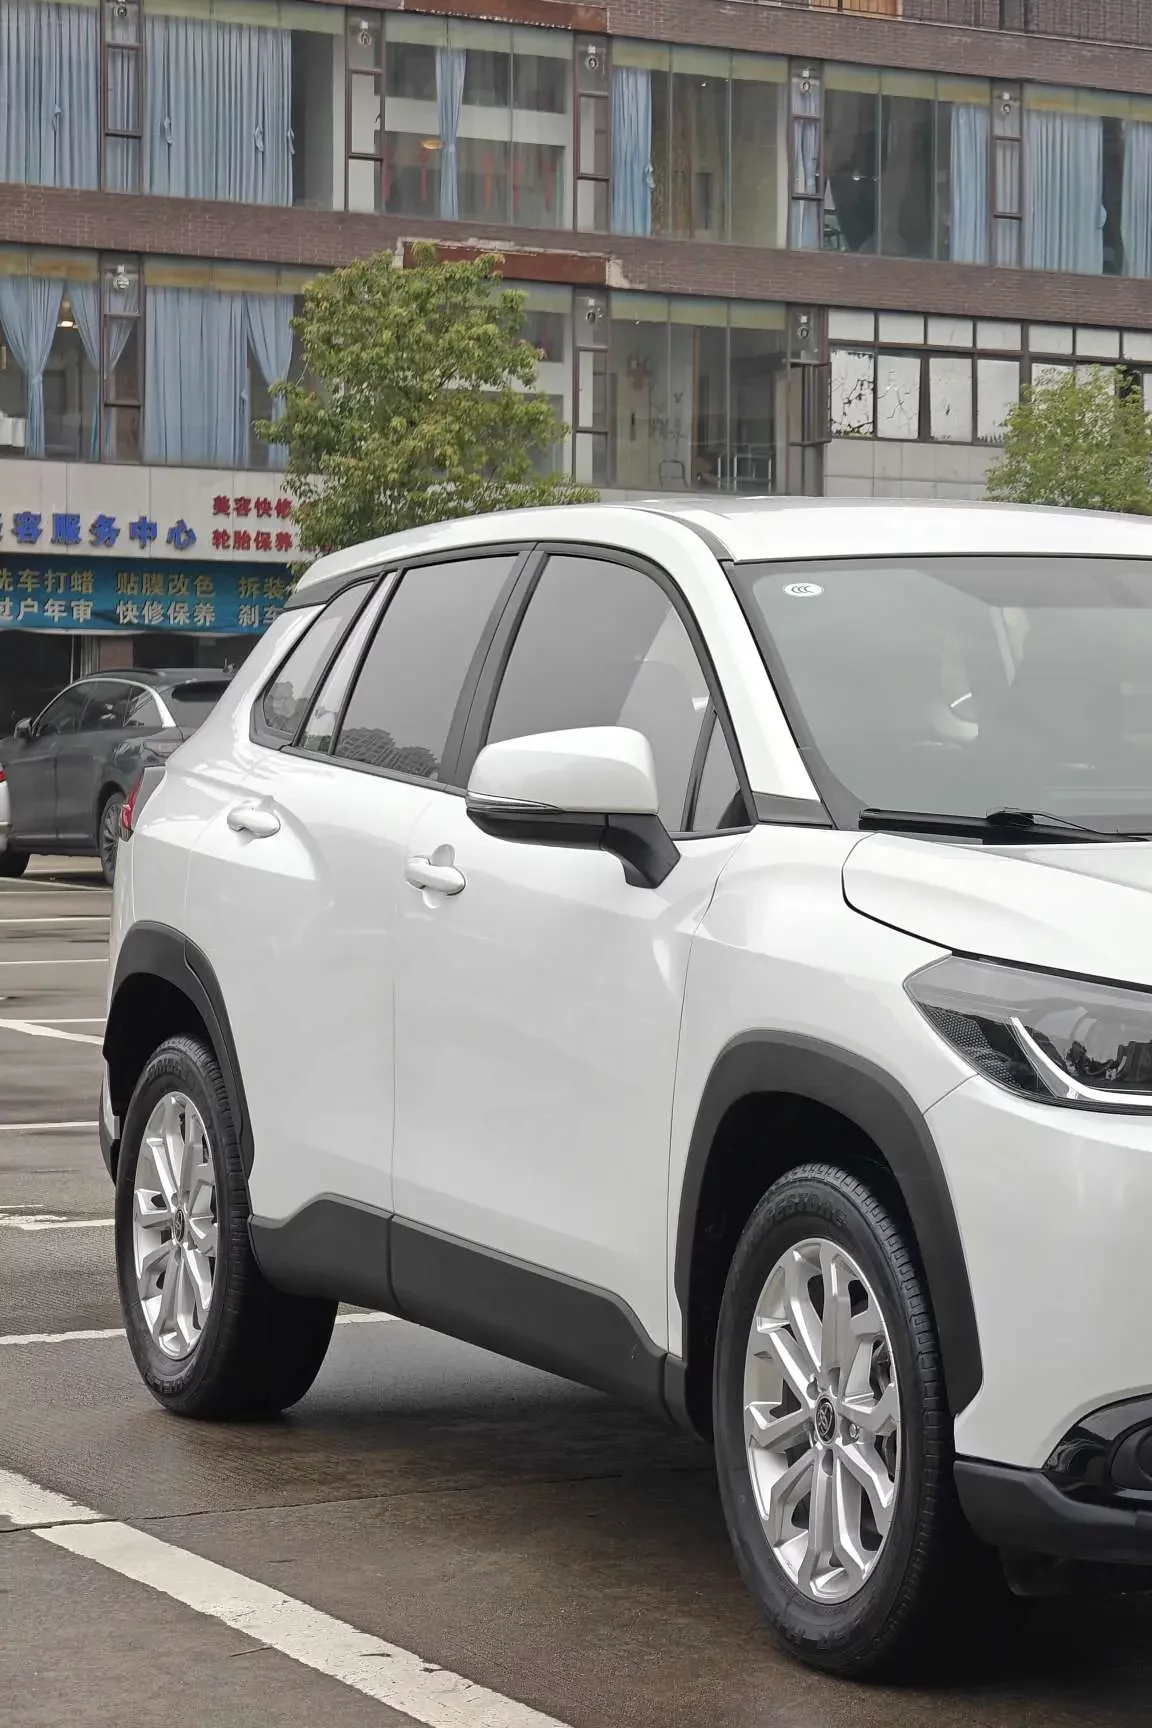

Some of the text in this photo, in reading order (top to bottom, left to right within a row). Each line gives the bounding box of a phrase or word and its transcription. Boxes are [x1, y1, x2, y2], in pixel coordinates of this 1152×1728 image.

[0, 511, 197, 550] 客服务中心
[211, 528, 293, 552] 轮胎保养
[116, 571, 216, 598] 贴膜改色
[116, 599, 216, 627] 快修保养
